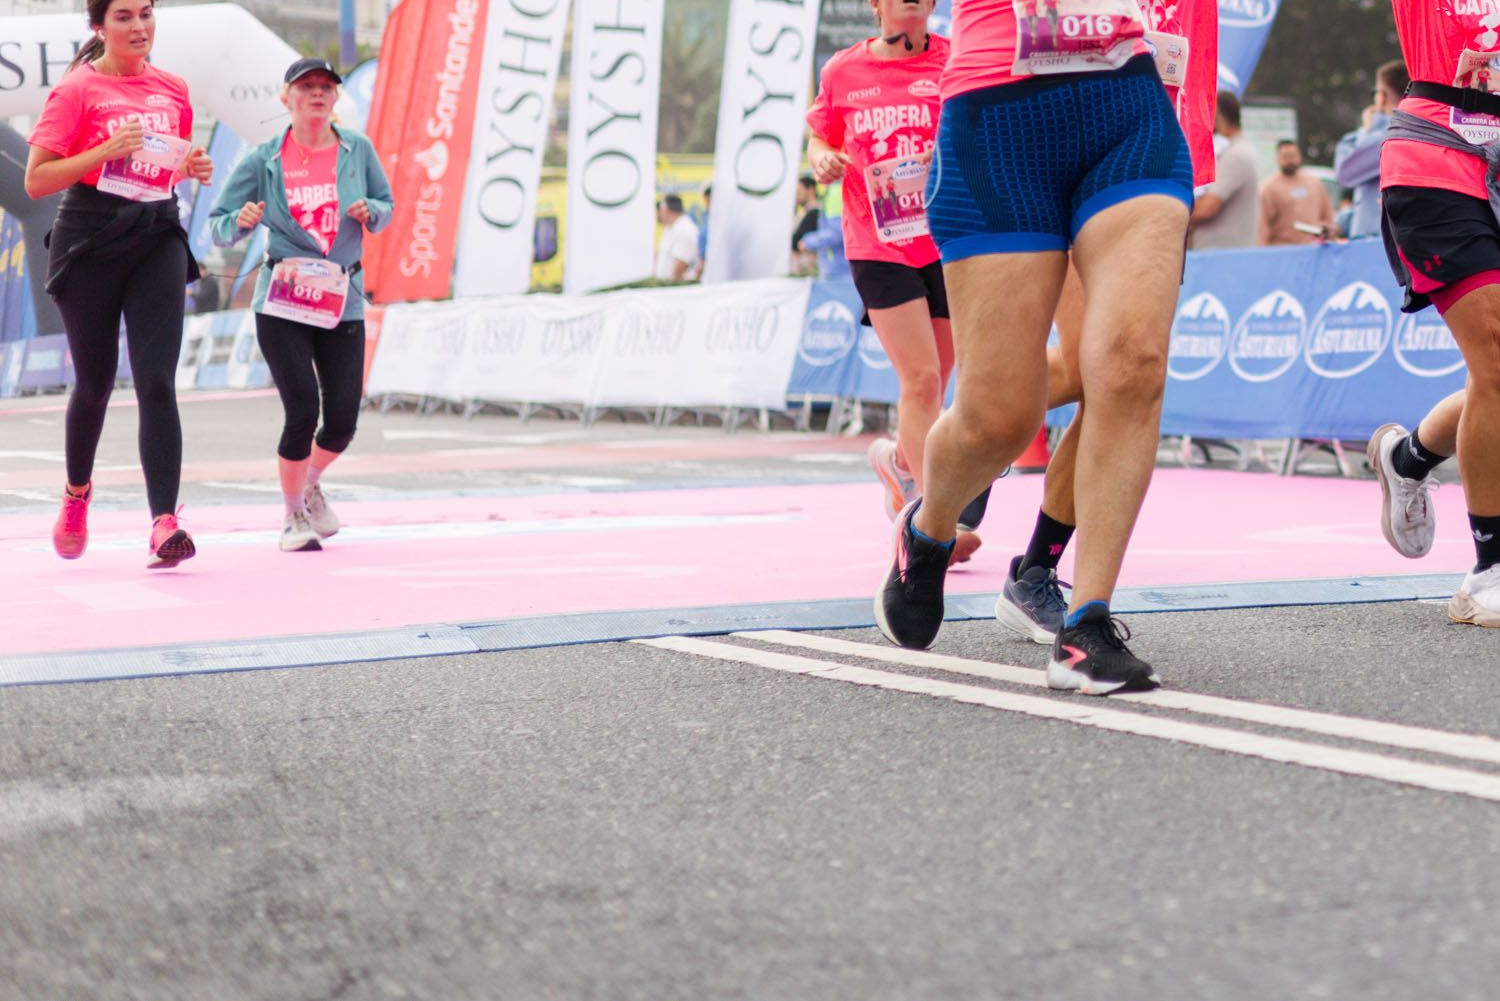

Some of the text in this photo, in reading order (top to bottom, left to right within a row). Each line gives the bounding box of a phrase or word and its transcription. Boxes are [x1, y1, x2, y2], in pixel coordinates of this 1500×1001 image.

[1062, 16, 1114, 37] 016
[1463, 130, 1500, 140] OYSHO
[131, 160, 160, 178] 016
[294, 285, 323, 300] 016
